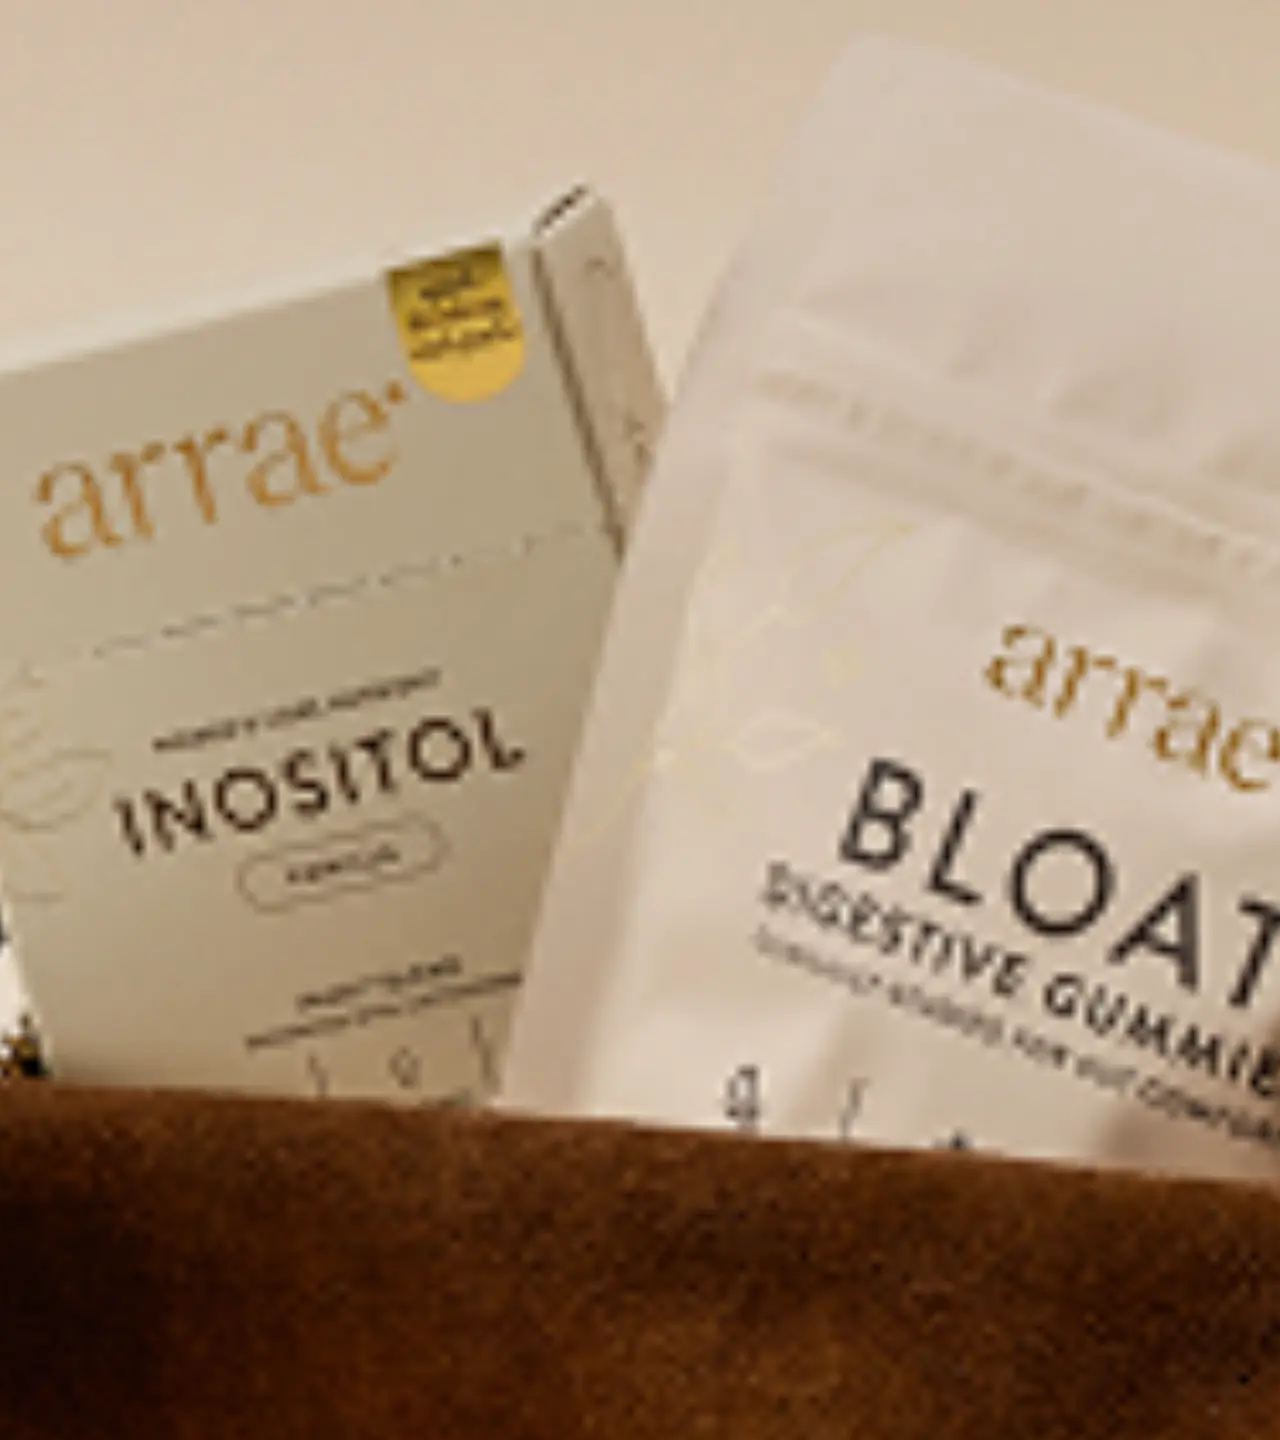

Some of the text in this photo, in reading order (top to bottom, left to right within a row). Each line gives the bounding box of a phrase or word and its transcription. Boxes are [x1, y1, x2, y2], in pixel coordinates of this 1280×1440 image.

[31, 385, 404, 560] arrae
[114, 706, 527, 858] INOSITOL
[761, 860, 1031, 999] DIGESTIVE
